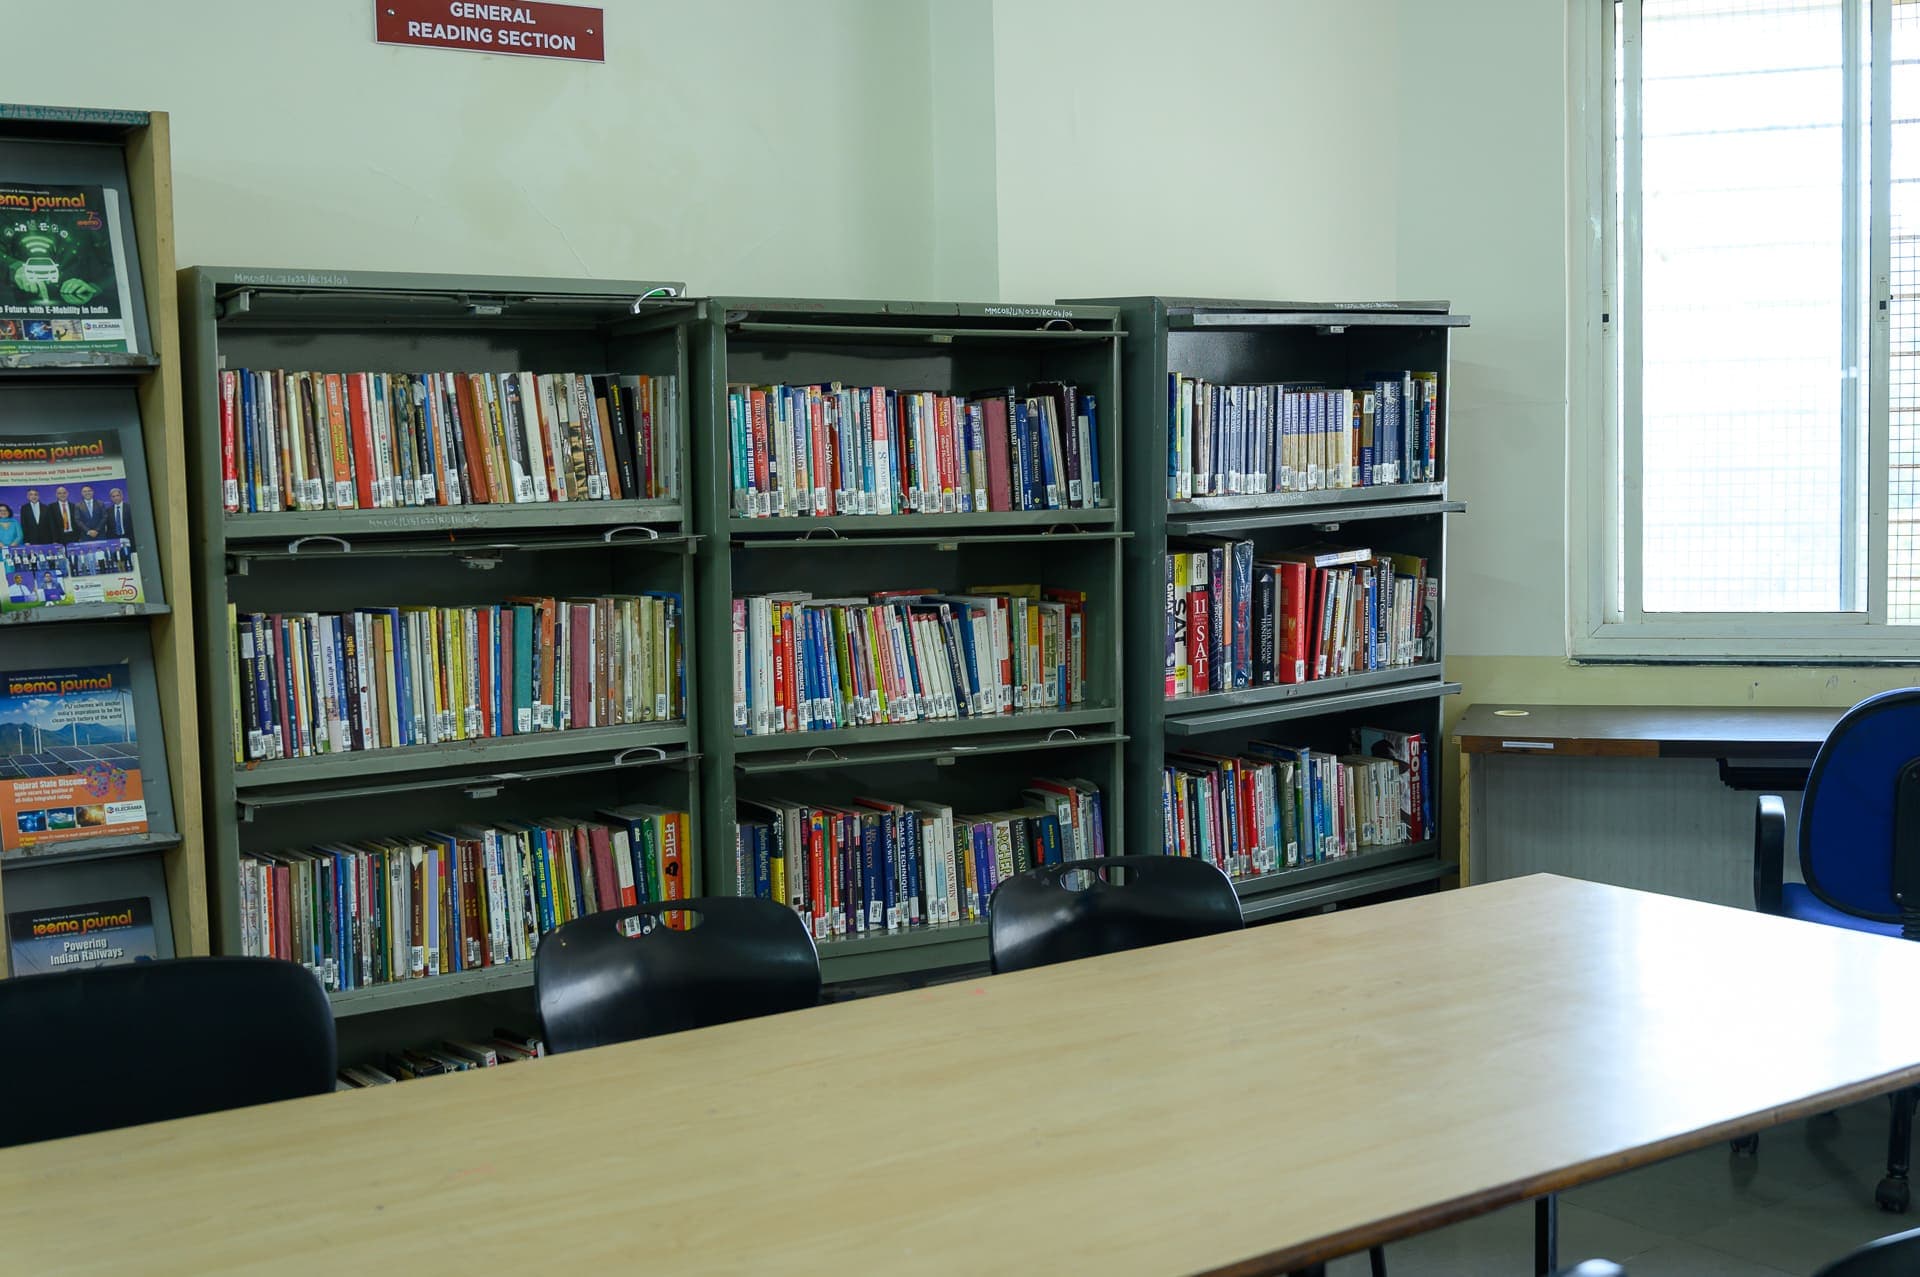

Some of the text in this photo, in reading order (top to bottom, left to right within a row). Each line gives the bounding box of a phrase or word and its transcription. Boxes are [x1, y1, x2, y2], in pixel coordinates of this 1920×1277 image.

[450, 2, 536, 24] GENERAL
[408, 21, 576, 51] READING SECTION
[31, 193, 86, 213] journal
[5, 305, 27, 313] Future
[29, 305, 44, 313] with
[754, 399, 765, 464] LIBRARY SCIENCE
[1010, 416, 1018, 445] HUBBARD
[48, 440, 104, 464] journal
[796, 438, 806, 471] ENERGY
[825, 443, 834, 466] STAY
[106, 588, 134, 597] ieema
[1166, 582, 1174, 615] GMAT
[1193, 599, 1207, 615] 11
[1174, 598, 1187, 646] SAT
[1194, 625, 1208, 675] SAT
[9, 681, 57, 695] ieema
[58, 673, 112, 697] journal
[1410, 740, 1420, 782] 501
[664, 821, 677, 858] मनात
[865, 830, 873, 868] TOLSTOY
[997, 825, 1014, 878] ARCHER
[759, 828, 769, 881] Modern Marketing
[900, 850, 908, 901] TECHNIQUES
[989, 865, 997, 885] STRESS
[33, 919, 79, 935] ieema
[80, 909, 132, 935] journal
[50, 946, 123, 966] Indian Railways
[64, 938, 107, 952] Powering
